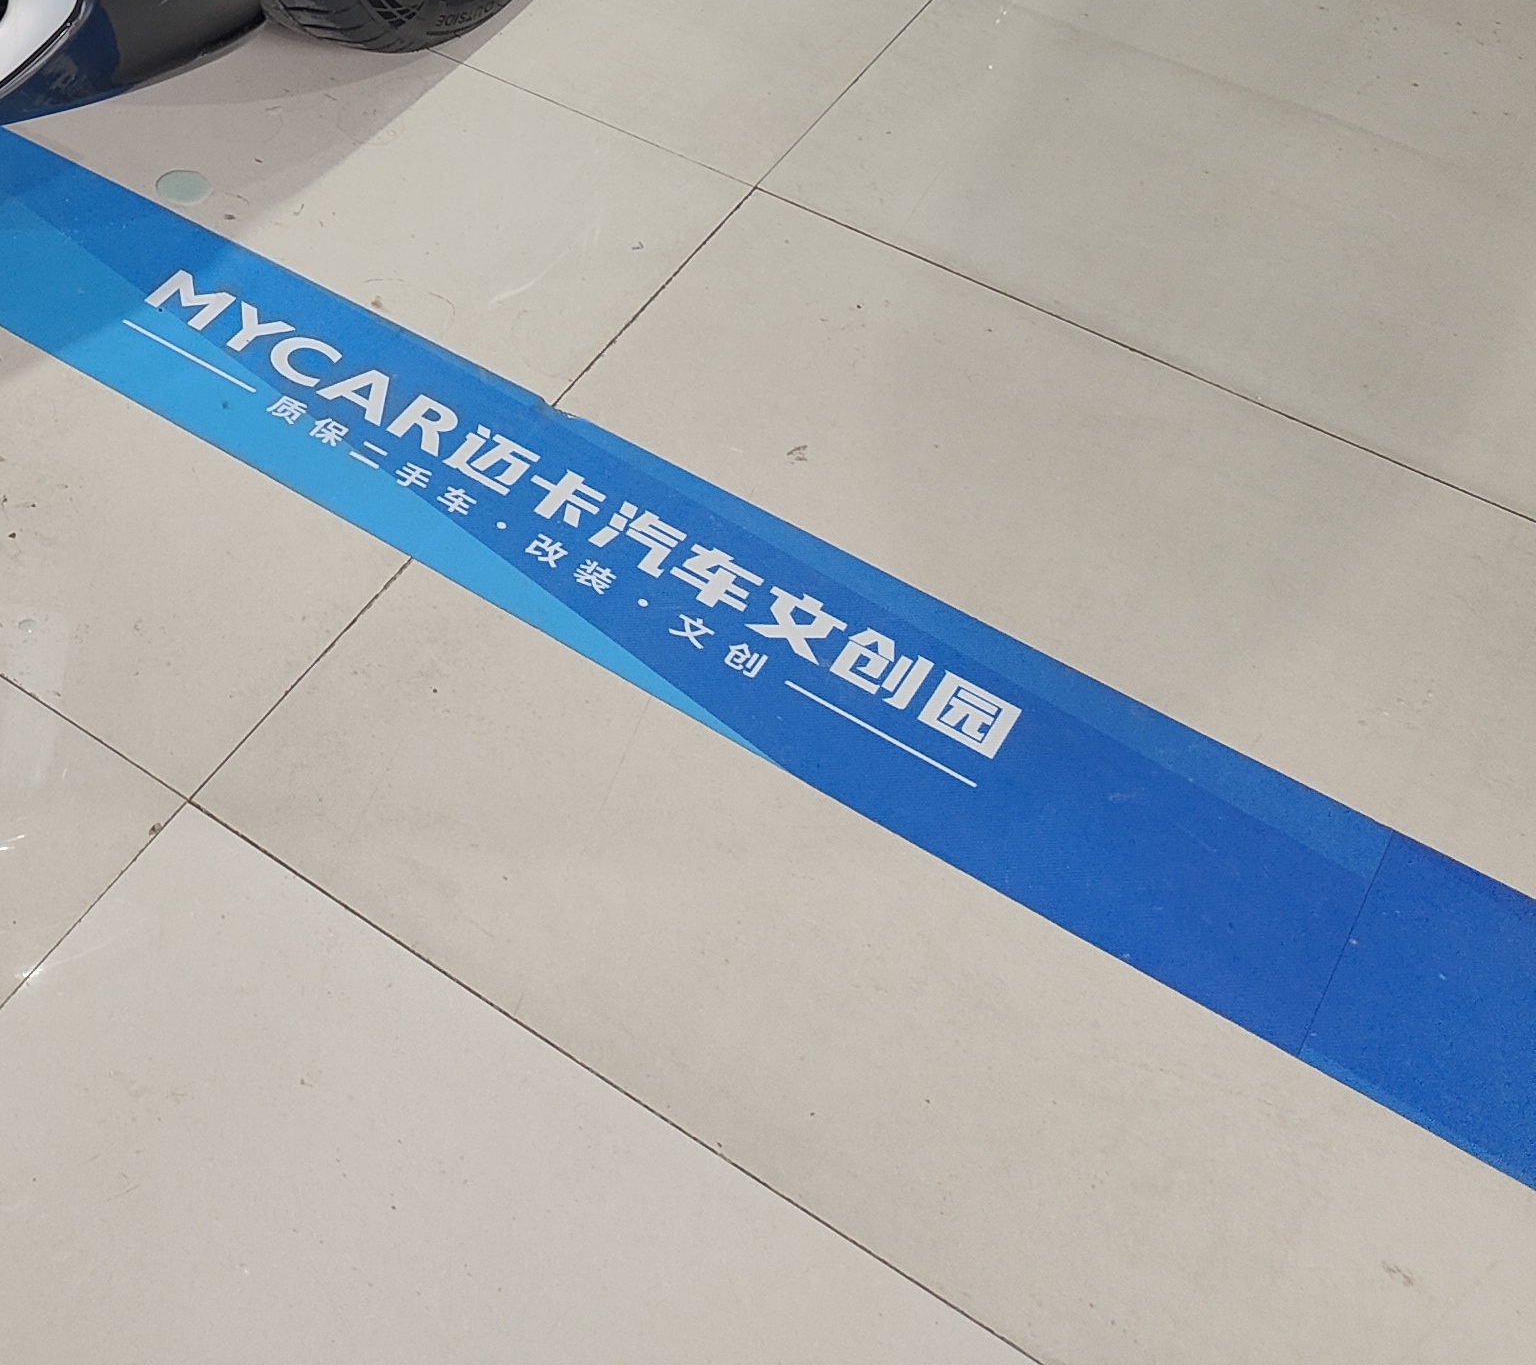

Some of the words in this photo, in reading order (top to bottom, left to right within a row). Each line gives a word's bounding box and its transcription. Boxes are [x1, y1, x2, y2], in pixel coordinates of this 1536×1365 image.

[144, 269, 1023, 760] MYCAR迈卡汽车文创园
[266, 395, 769, 678] 质保二手车·改装·文创
